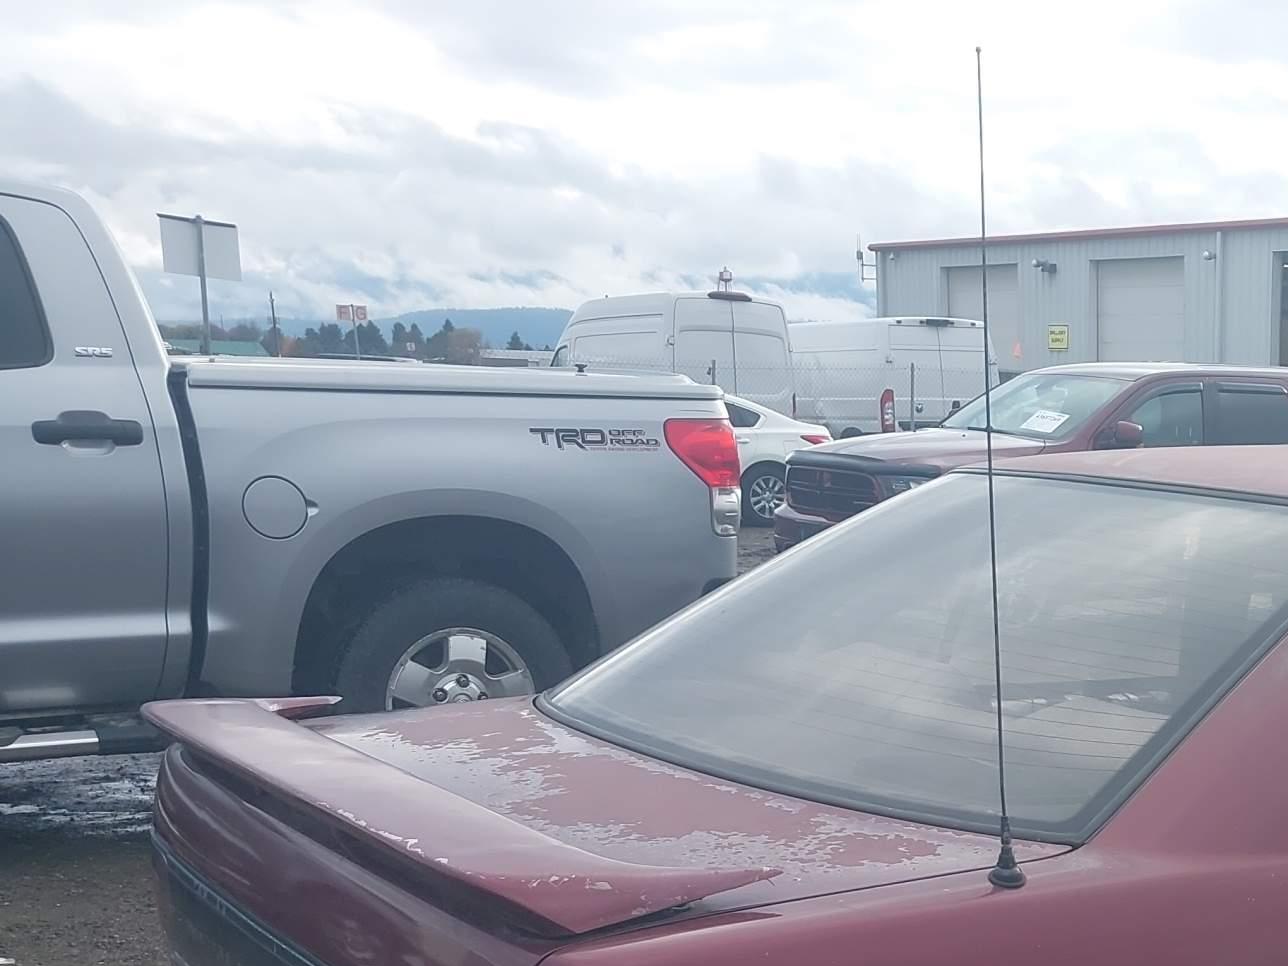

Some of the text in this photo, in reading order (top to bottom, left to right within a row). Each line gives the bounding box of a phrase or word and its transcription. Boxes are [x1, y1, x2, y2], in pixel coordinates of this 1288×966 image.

[529, 427, 646, 451] TRD OFF
[608, 438, 660, 448] ROAD
